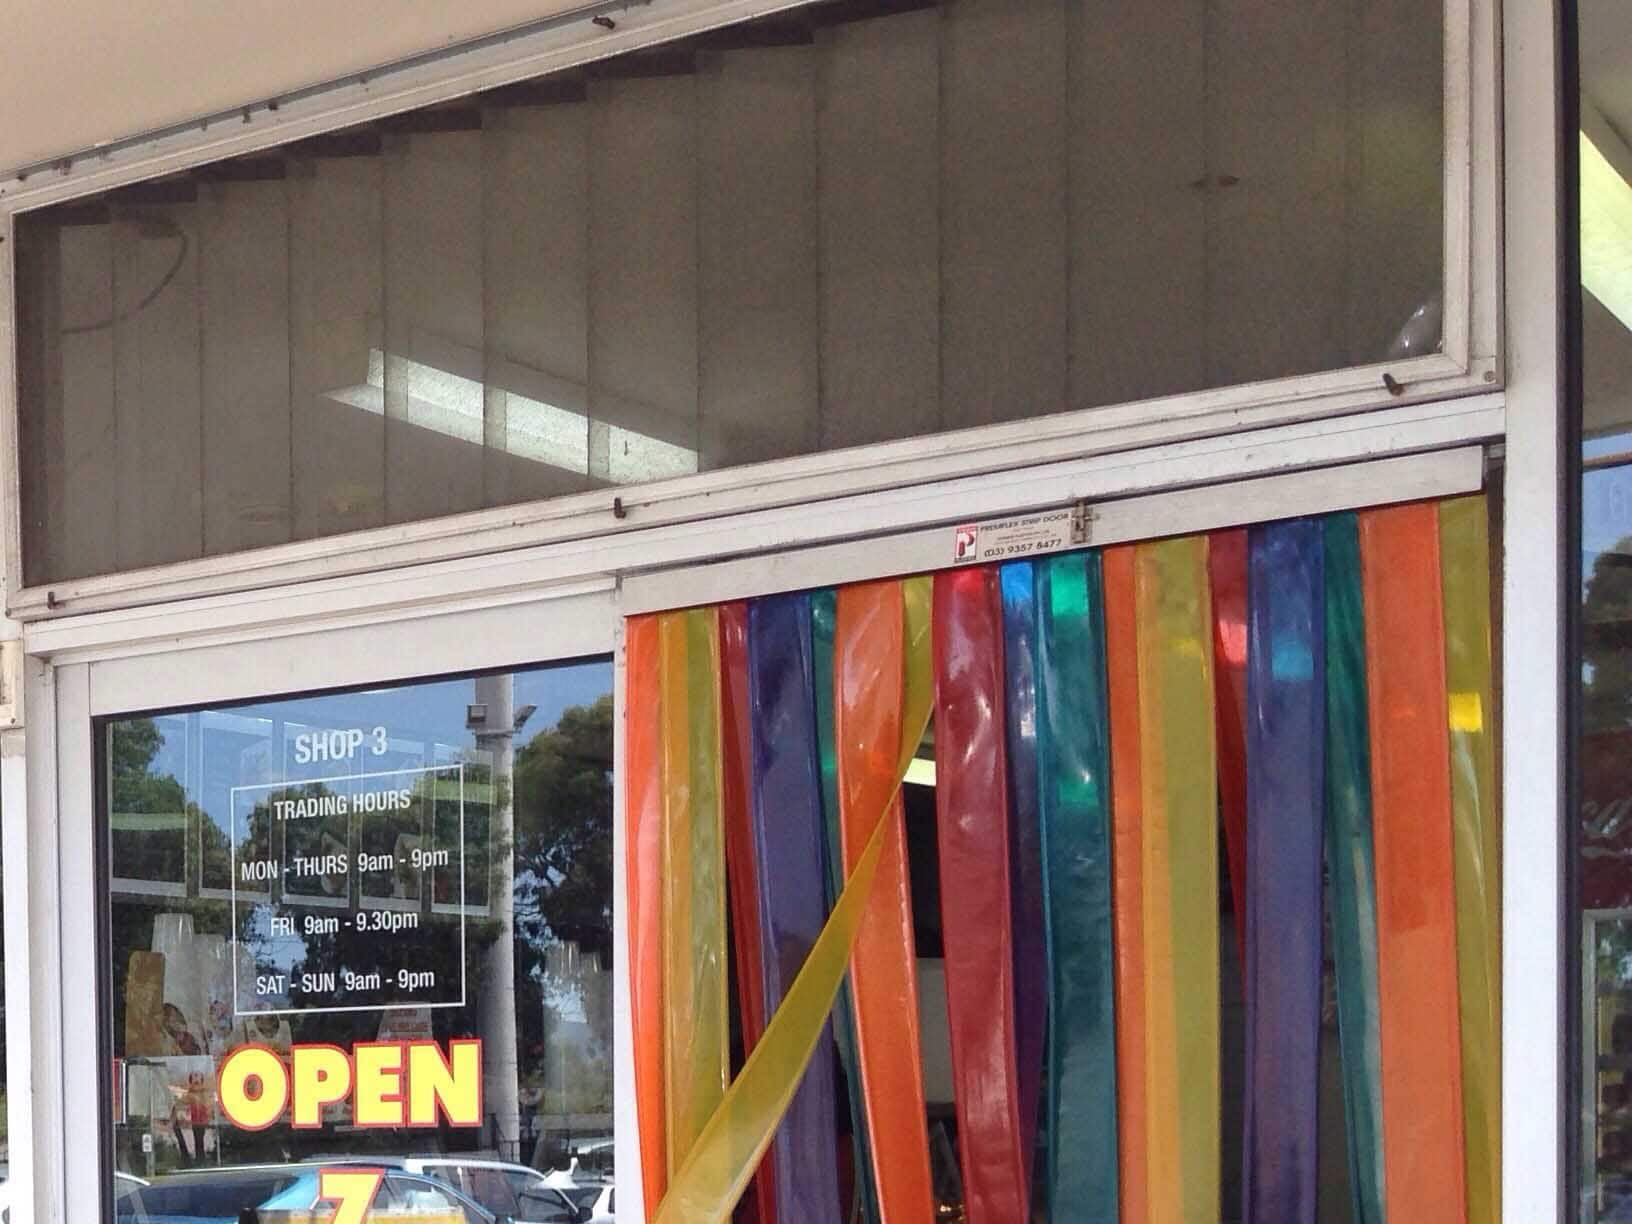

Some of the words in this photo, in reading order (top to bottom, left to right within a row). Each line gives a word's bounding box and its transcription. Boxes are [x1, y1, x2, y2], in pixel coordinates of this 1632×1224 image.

[295, 728, 363, 764] SHOP
[371, 726, 388, 758] 3
[274, 795, 348, 821] TRADING
[352, 788, 411, 813] HOURS
[241, 859, 278, 881] MON
[294, 852, 348, 876] THURS
[357, 852, 393, 873] 9am
[411, 848, 449, 872] 9pm
[270, 916, 297, 937] FRI
[304, 914, 339, 935] 9am
[355, 910, 419, 934] 9.30pm
[256, 975, 285, 996] SAT
[302, 971, 336, 993] SUN
[345, 971, 381, 991] 9am
[398, 968, 435, 992] 9pm
[217, 1038, 483, 1132] OPEN
